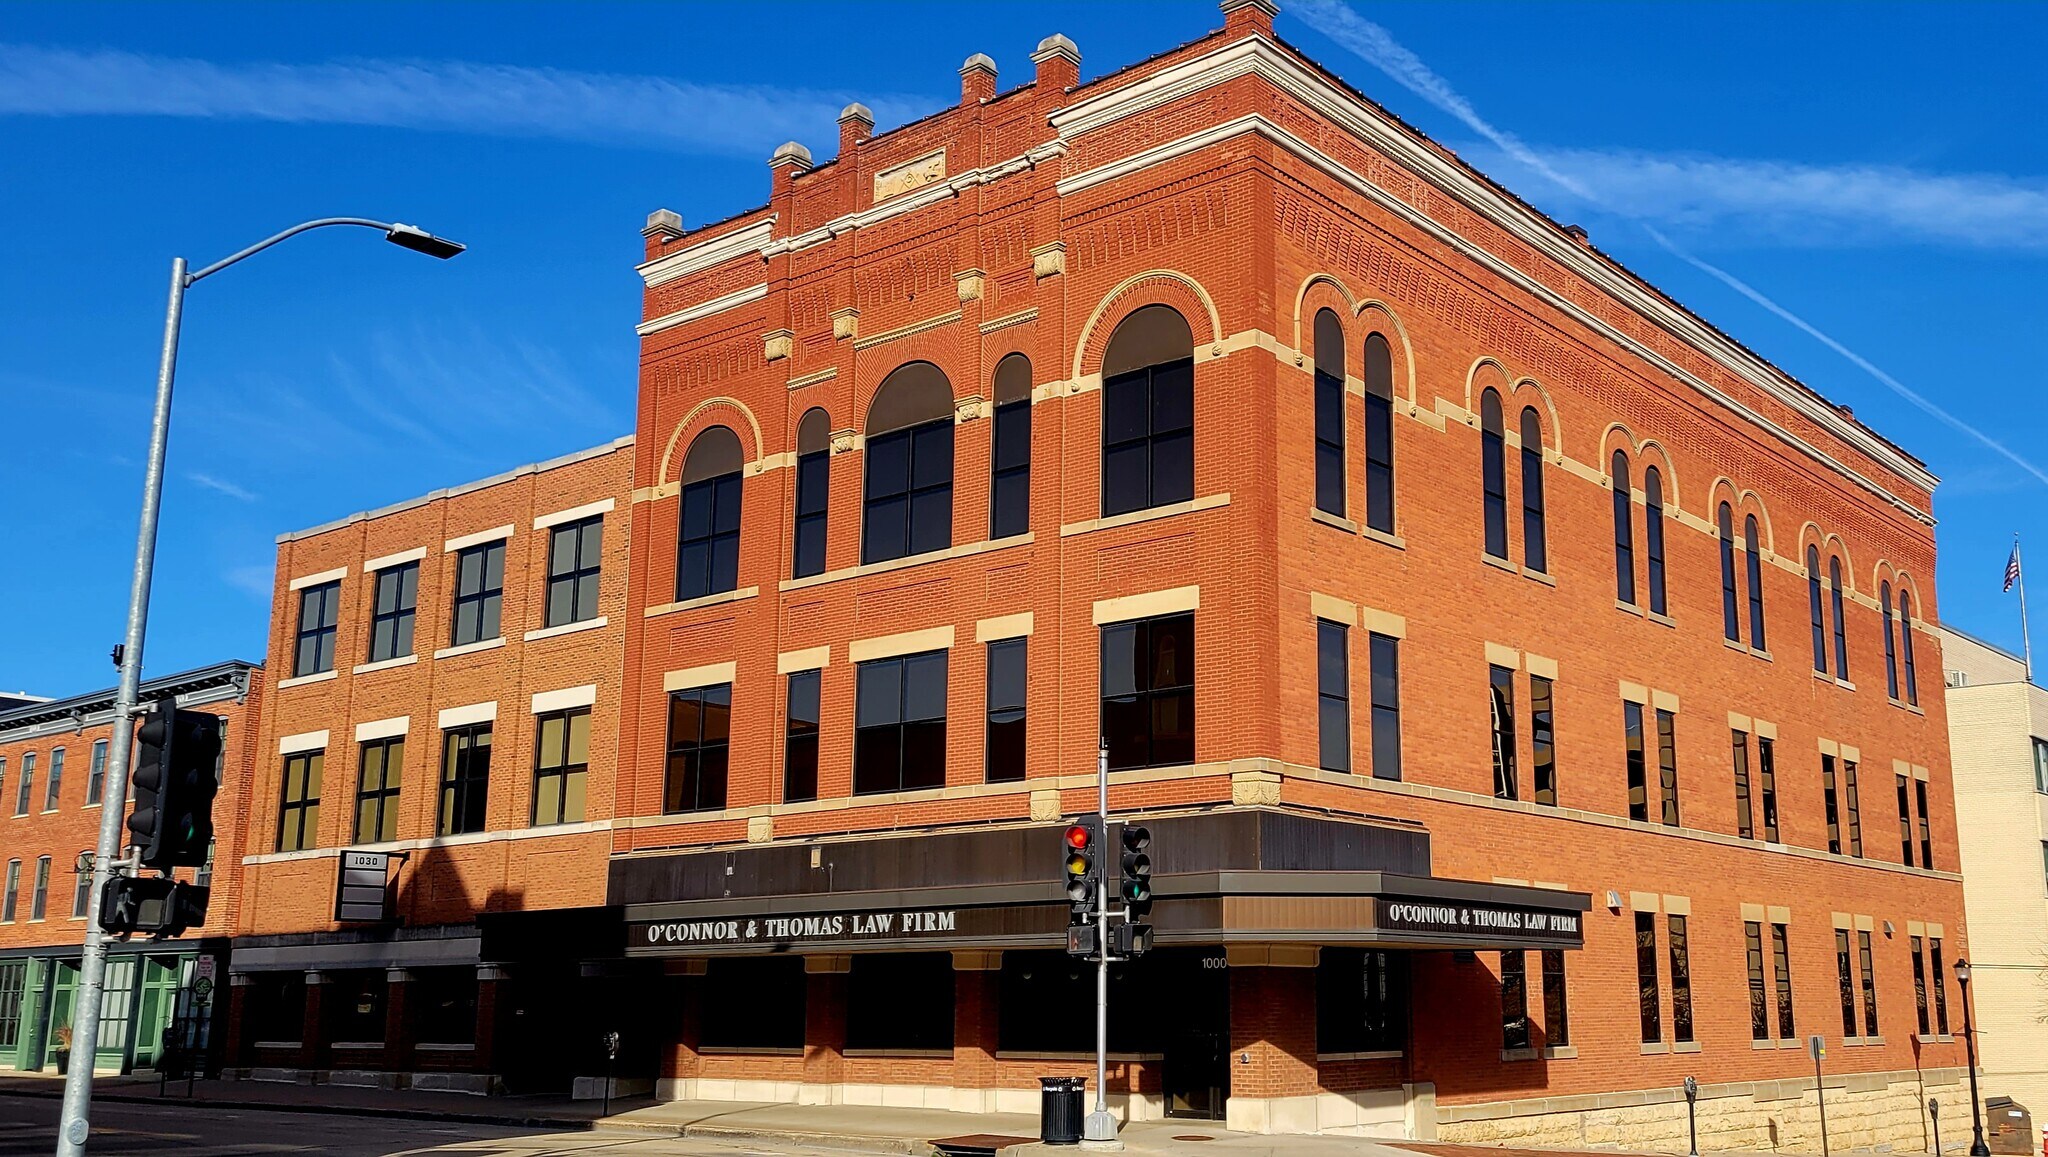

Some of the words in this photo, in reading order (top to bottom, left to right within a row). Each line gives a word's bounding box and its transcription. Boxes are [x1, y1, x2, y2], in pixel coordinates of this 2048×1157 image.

[355, 856, 378, 866] 1030
[647, 921, 738, 943] O'CONNOR
[745, 920, 758, 938] &
[765, 916, 843, 938] THOMAS
[852, 913, 894, 934] LAW
[901, 911, 956, 932] FIRM
[1389, 904, 1457, 925] O'CONNOR
[1460, 909, 1470, 925] &
[1472, 909, 1521, 929] THOMAS
[1524, 913, 1547, 930] LAW
[1550, 915, 1577, 933] FIRM
[1202, 957, 1227, 969] 1000
